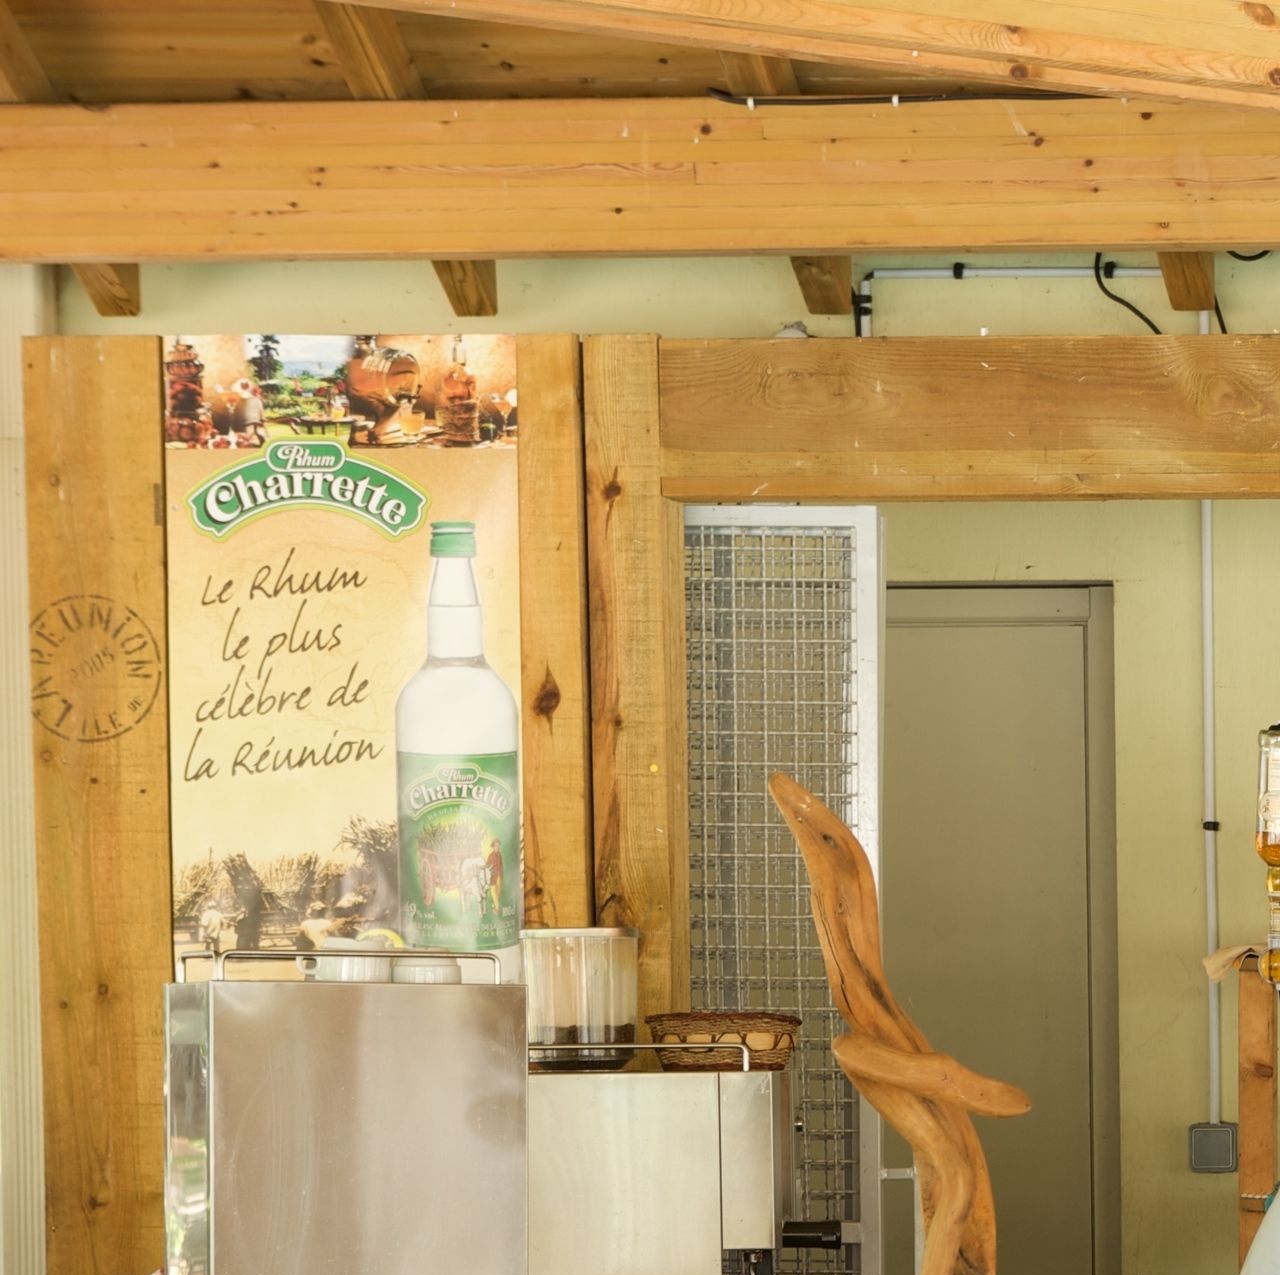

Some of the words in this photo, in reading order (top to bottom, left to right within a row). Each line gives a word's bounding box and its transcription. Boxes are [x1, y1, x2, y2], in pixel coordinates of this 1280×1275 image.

[276, 444, 335, 469] Rhum
[205, 472, 407, 525] Charrette
[201, 574, 233, 606] Le
[249, 547, 368, 601] Rhum
[222, 607, 250, 662] le
[256, 598, 343, 679] plus
[195, 664, 312, 723] célèbre
[326, 661, 370, 706] de
[184, 727, 218, 782] la
[231, 729, 385, 777] Réunion
[410, 782, 508, 811] Charrette
